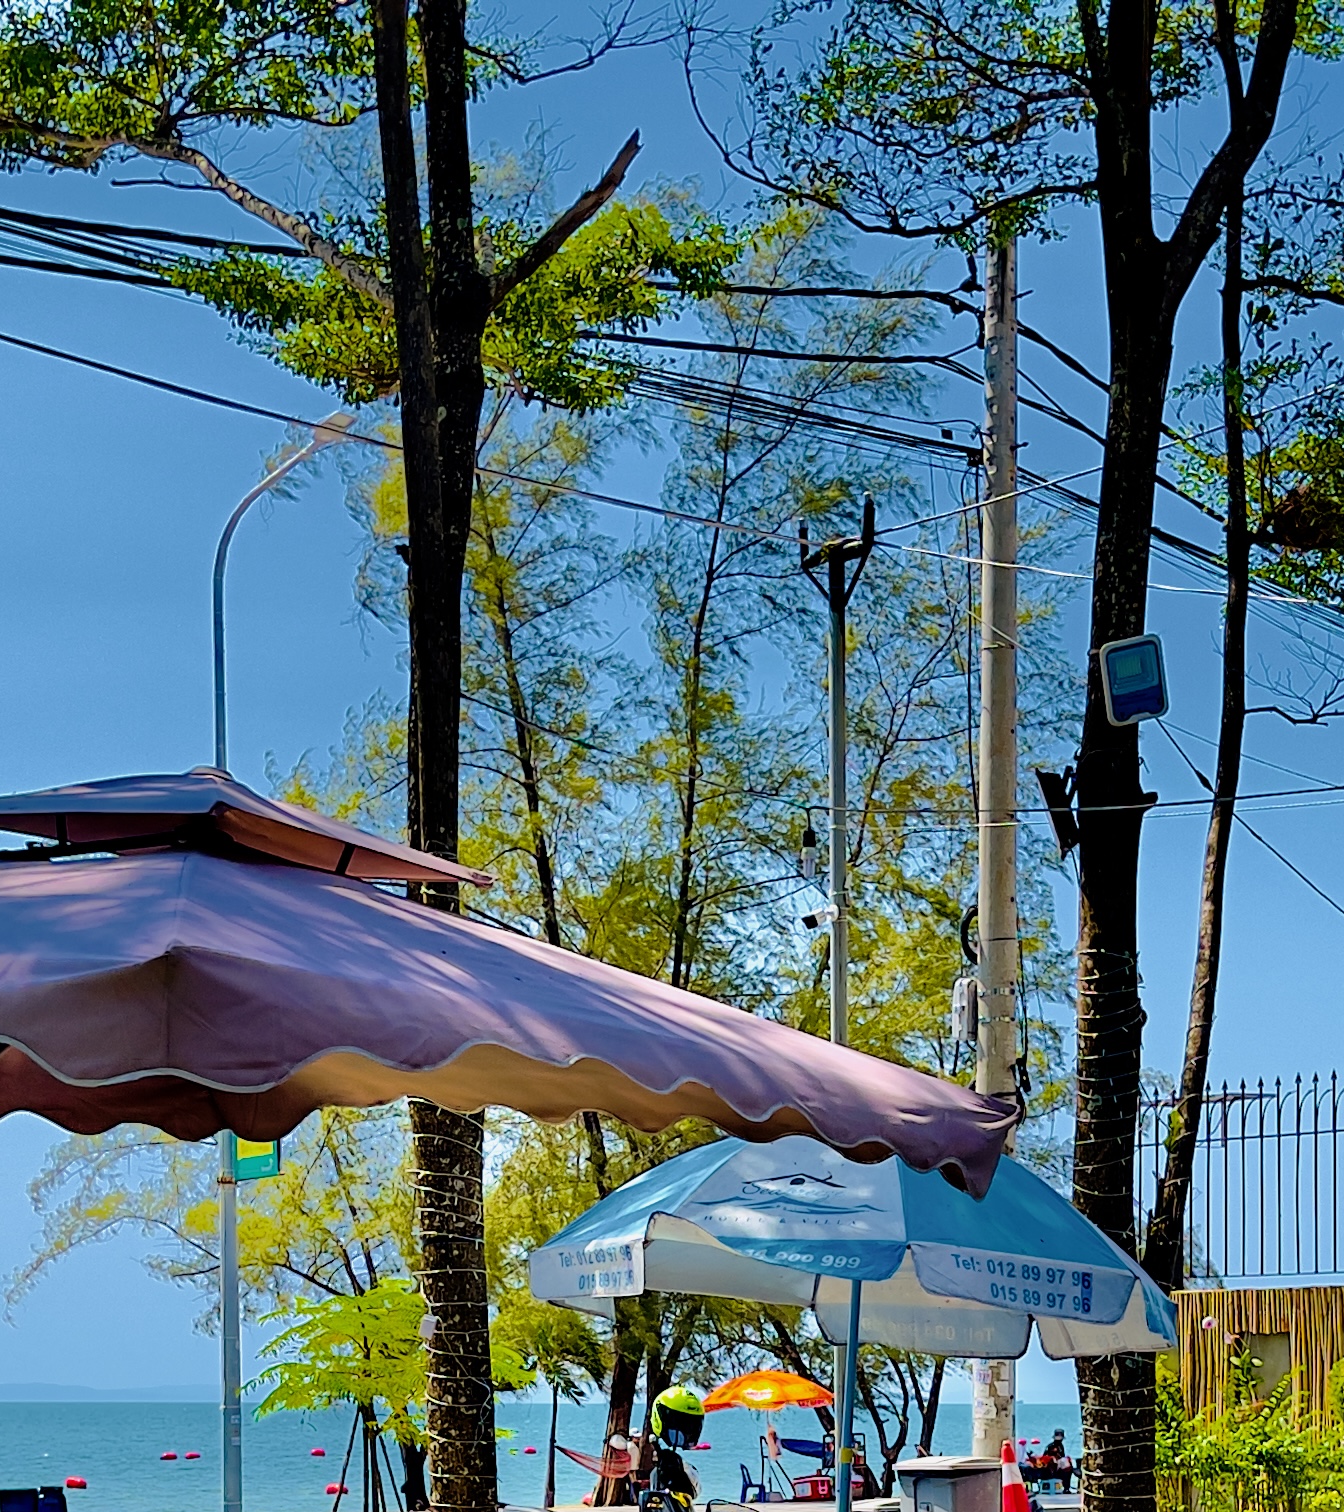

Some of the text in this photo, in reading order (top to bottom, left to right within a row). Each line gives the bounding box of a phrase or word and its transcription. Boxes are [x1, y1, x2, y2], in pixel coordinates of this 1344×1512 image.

[558, 1250, 577, 1268] Tel:
[576, 1249, 594, 1266] 012
[596, 1247, 606, 1263] 89
[820, 1254, 862, 1269] 999
[950, 1253, 1093, 1291] Tel: 012 89 97 96
[989, 1282, 1093, 1315] 015 89 97 96
